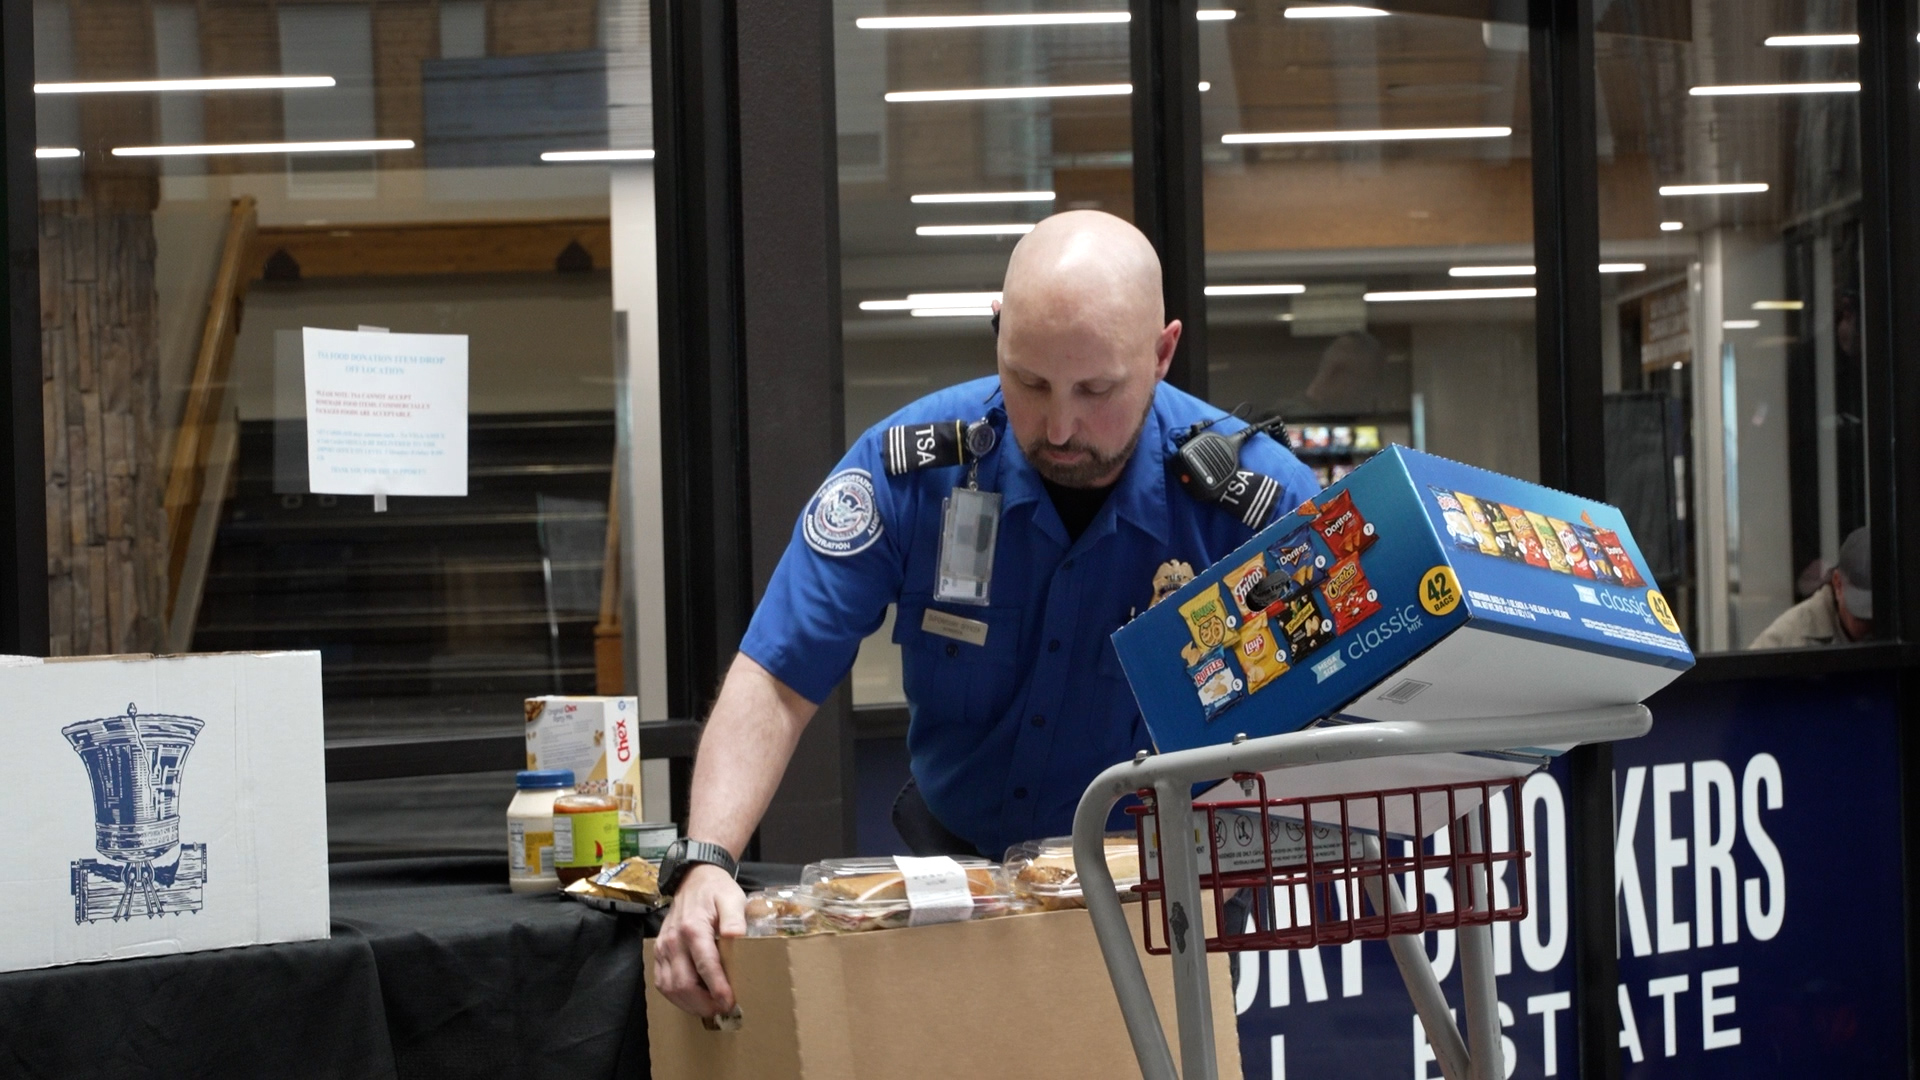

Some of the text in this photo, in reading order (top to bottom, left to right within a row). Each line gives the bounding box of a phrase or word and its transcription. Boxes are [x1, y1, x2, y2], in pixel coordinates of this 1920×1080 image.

[351, 352, 393, 363] DONATION
[394, 355, 418, 364] ITEM
[419, 356, 446, 365] DROP
[361, 366, 405, 375] LOCATION
[915, 424, 936, 466] TSA
[1219, 470, 1254, 505] TSA
[1325, 509, 1353, 538] Doritos
[1279, 541, 1309, 566] Doritos
[1235, 567, 1264, 605] Fritos
[1327, 564, 1356, 600] Cheetos
[1427, 572, 1452, 603] 42
[1434, 595, 1455, 611] BAGS
[1600, 588, 1652, 618] classic
[1652, 597, 1672, 619] 42
[1324, 621, 1330, 630] 4
[1347, 603, 1420, 660] classic
[1407, 620, 1424, 635] MIX
[1245, 634, 1264, 655] Lay's
[1278, 652, 1284, 661] 5
[1317, 656, 1338, 671] MEGA
[1194, 658, 1225, 684] RUFFLES
[1323, 664, 1339, 677] SIZE
[1235, 680, 1240, 689] 5
[616, 718, 631, 763] Chex
